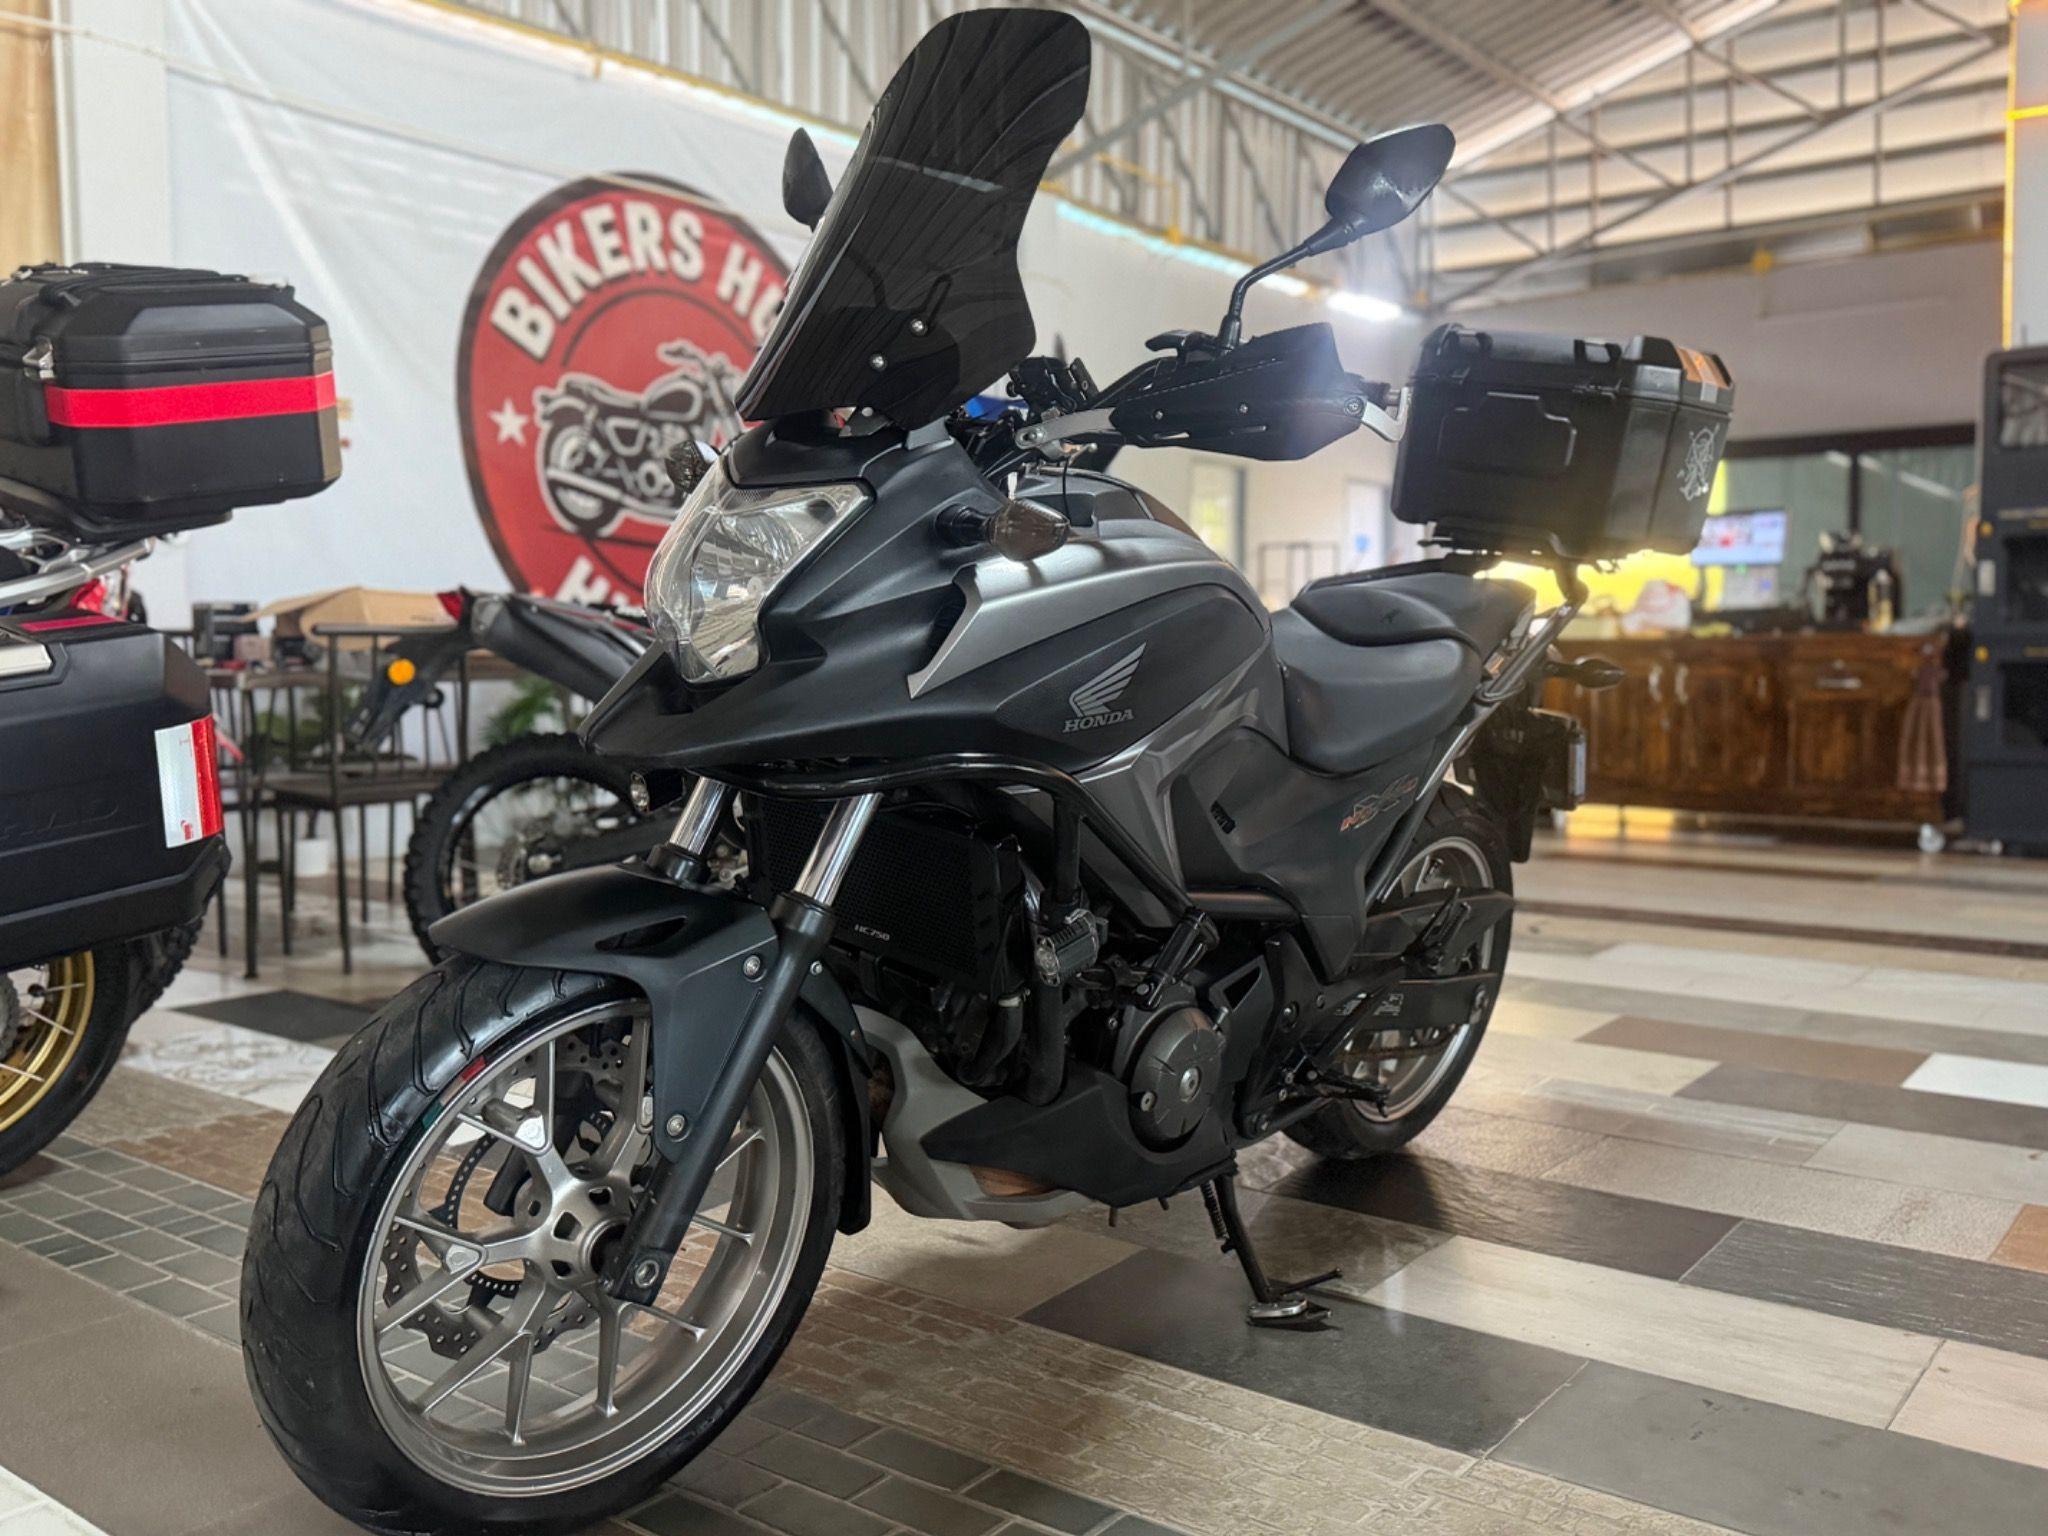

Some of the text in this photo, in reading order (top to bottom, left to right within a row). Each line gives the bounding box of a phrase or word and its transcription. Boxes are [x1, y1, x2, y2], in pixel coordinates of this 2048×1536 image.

[489, 200, 784, 362] BIKERS HU
[1062, 708, 1135, 733] HONDA
